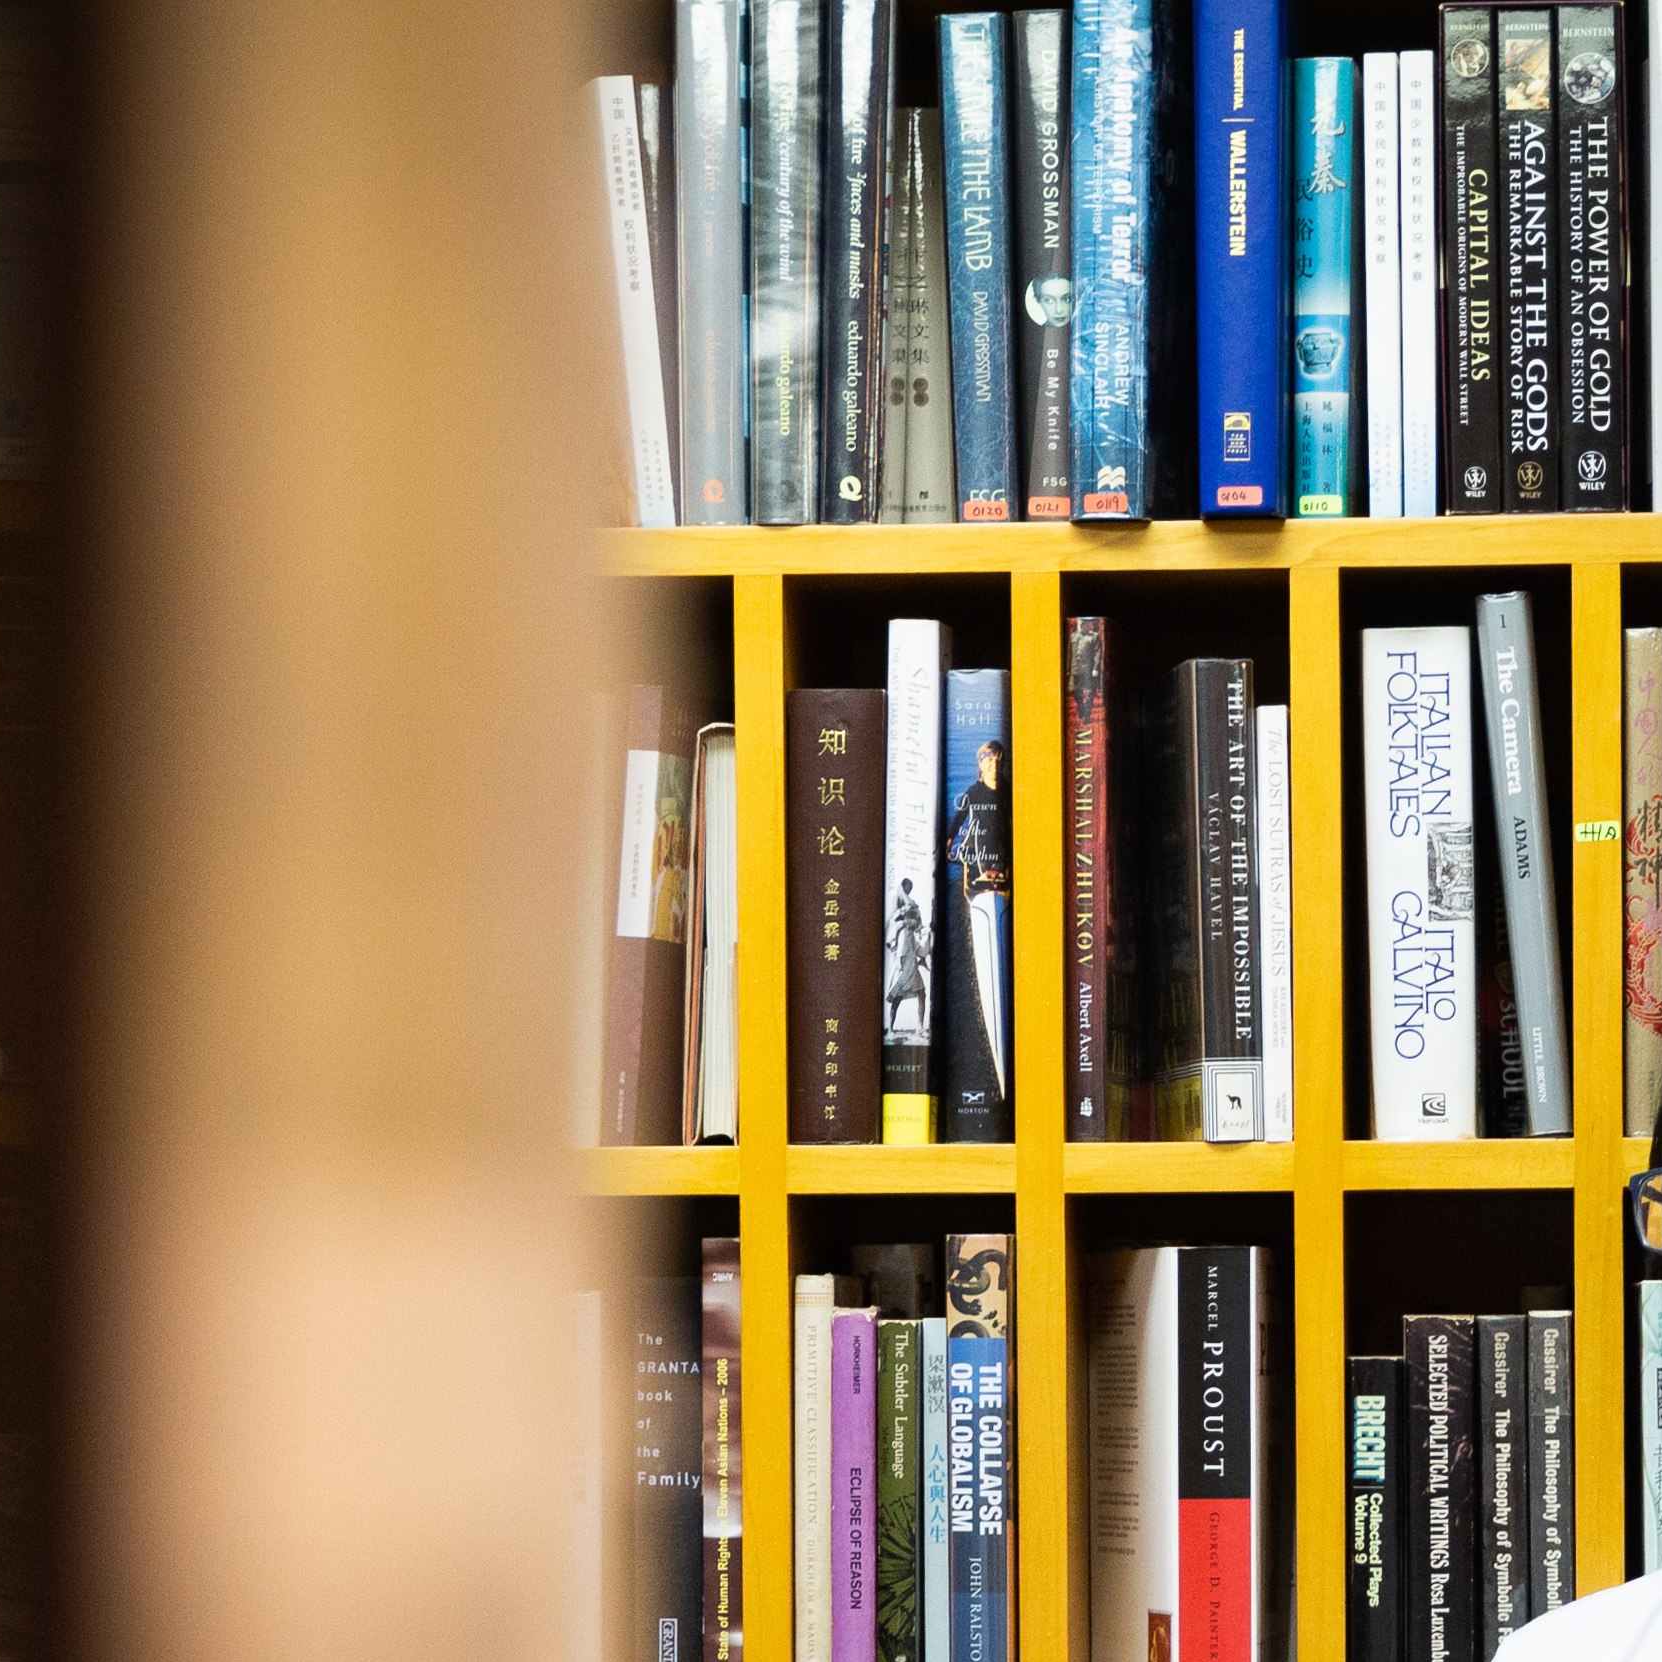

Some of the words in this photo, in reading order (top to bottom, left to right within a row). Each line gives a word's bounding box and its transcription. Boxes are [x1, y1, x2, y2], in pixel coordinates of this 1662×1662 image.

[1042, 121, 1060, 248] GROSSMAN
[1588, 116, 1608, 178] THE
[1229, 129, 1247, 257] WALLERSTEIN
[1468, 168, 1490, 289] CAPITAL
[1524, 120, 1546, 269] AGAINST
[1588, 189, 1609, 293] POWER
[1470, 299, 1491, 381] IDEAS
[1525, 278, 1547, 347] THE
[1589, 302, 1610, 340] OF
[1526, 358, 1548, 451] GODS
[1590, 349, 1611, 432] GOLD
[1496, 646, 1518, 694] The
[1228, 740, 1246, 783] ART
[1386, 651, 1421, 839] FOLKTALES
[1419, 671, 1452, 816] ITALIAN
[1501, 698, 1522, 796] Camera
[816, 727, 848, 856] 知识论
[1075, 728, 1093, 847] MARSHAL
[1230, 795, 1246, 823] OF
[1231, 838, 1248, 885] THE
[1513, 816, 1530, 879] ADAMS
[1075, 853, 1093, 970] ZHUKOV
[1210, 876, 1223, 940] HAVEL
[1079, 982, 1092, 1029] Albert
[1233, 894, 1252, 1039] IMPOSSIBLE
[1391, 890, 1426, 1060] CALVINO
[1423, 929, 1457, 1022] ITALO
[1079, 1033, 1092, 1072] Axell
[1207, 1265, 1219, 1331] MARCEL
[950, 1362, 973, 1394] OF
[979, 1361, 1002, 1409] THE
[1202, 1341, 1225, 1477] PROUST
[950, 1400, 974, 1532] GLOBALISM
[979, 1415, 1002, 1536] COLLAPSE
[1354, 1395, 1386, 1482] BRECHT
[850, 1467, 862, 1526] ECLIPSE
[850, 1529, 862, 1548] OF
[850, 1553, 862, 1609] REASON
